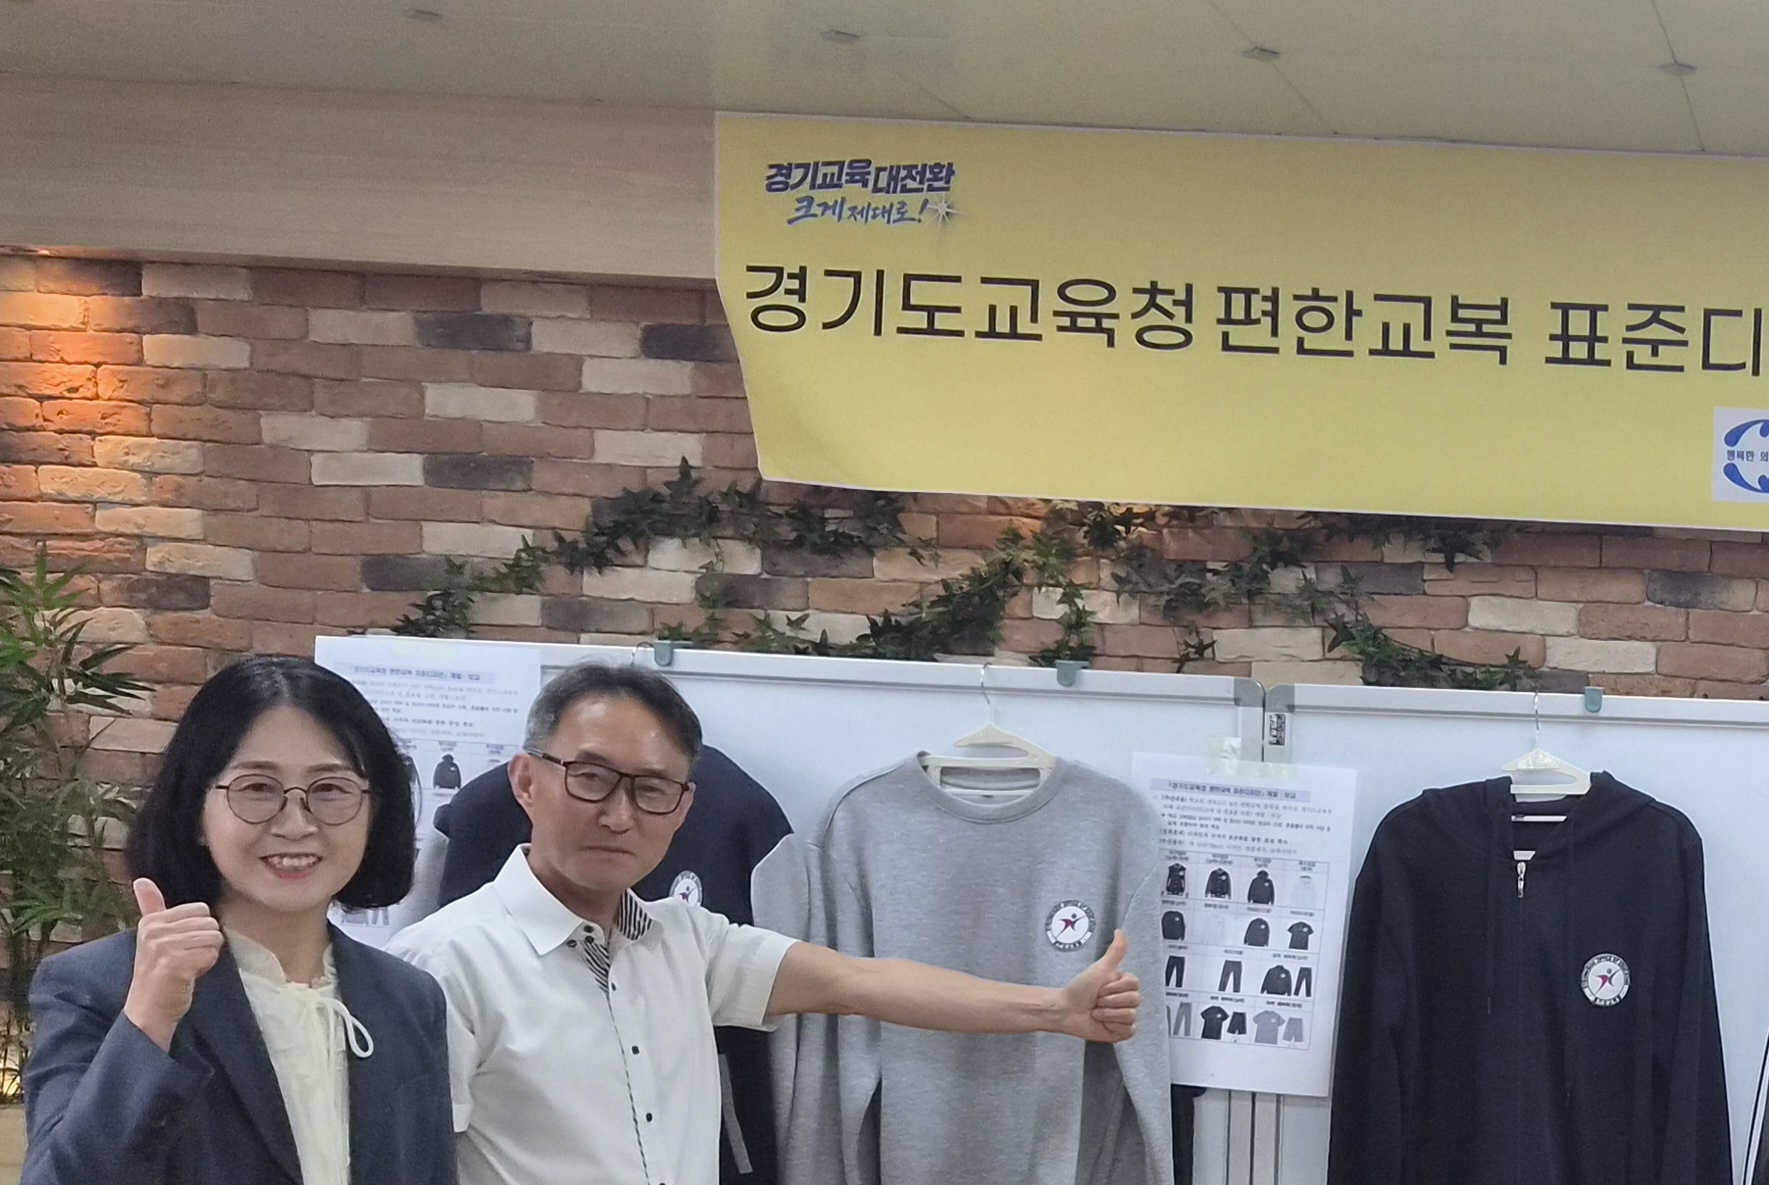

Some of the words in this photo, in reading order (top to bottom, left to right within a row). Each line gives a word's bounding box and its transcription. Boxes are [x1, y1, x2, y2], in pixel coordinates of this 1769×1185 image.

[765, 158, 872, 193] 경기교육
[871, 162, 955, 195] 대전환
[786, 195, 847, 225] 크게
[847, 198, 930, 225] 제대로!
[743, 263, 1195, 352] 경기도교육청
[1215, 284, 1515, 367] 편한교복
